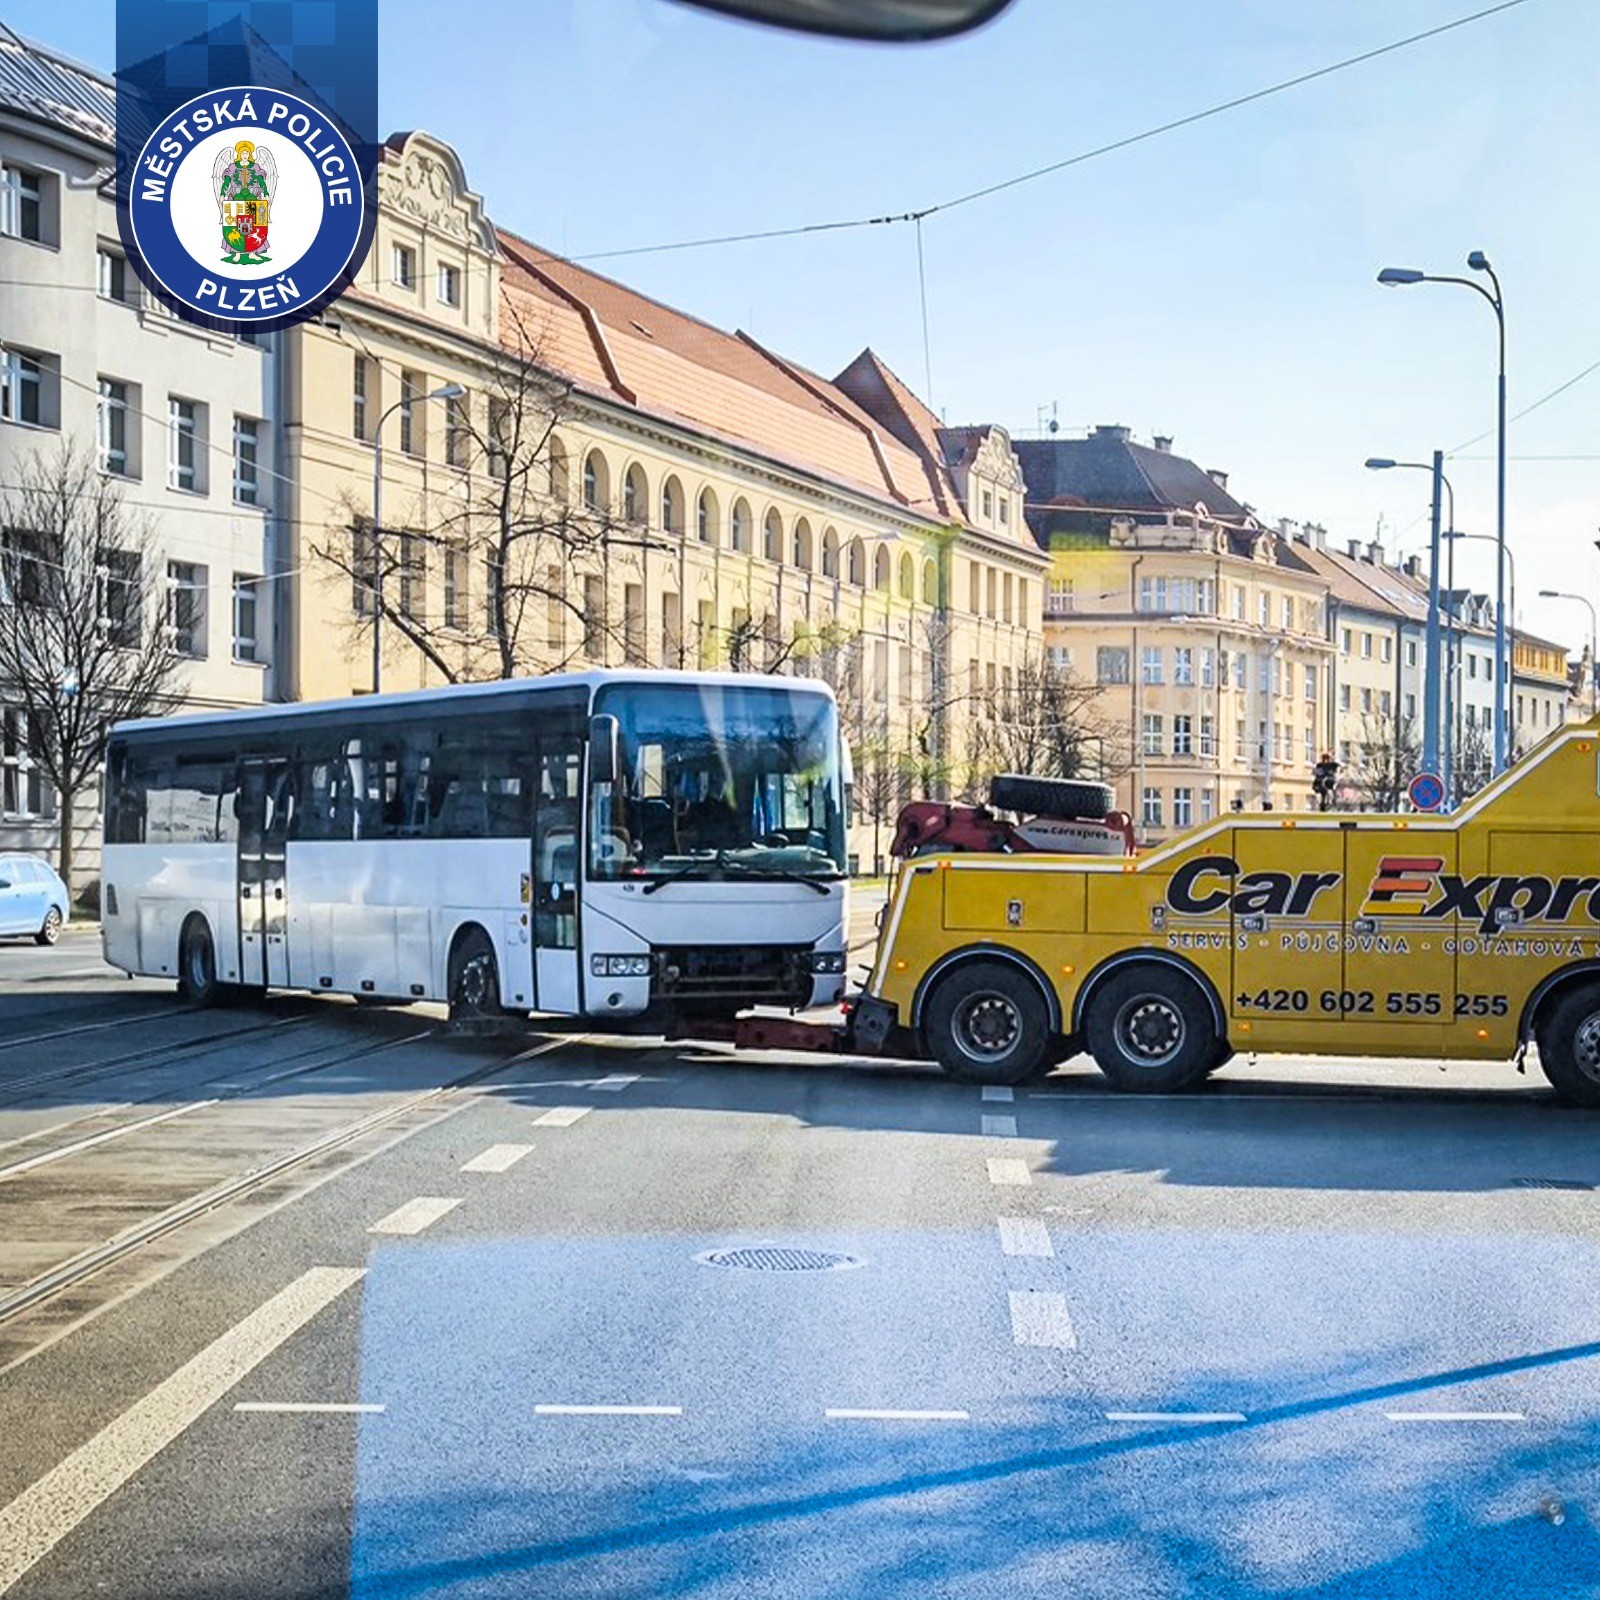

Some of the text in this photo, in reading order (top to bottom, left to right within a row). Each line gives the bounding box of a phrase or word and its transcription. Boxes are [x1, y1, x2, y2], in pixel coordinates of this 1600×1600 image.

[1166, 855, 1341, 915] Car
[1235, 989, 1509, 1017] +420 602 555 255
